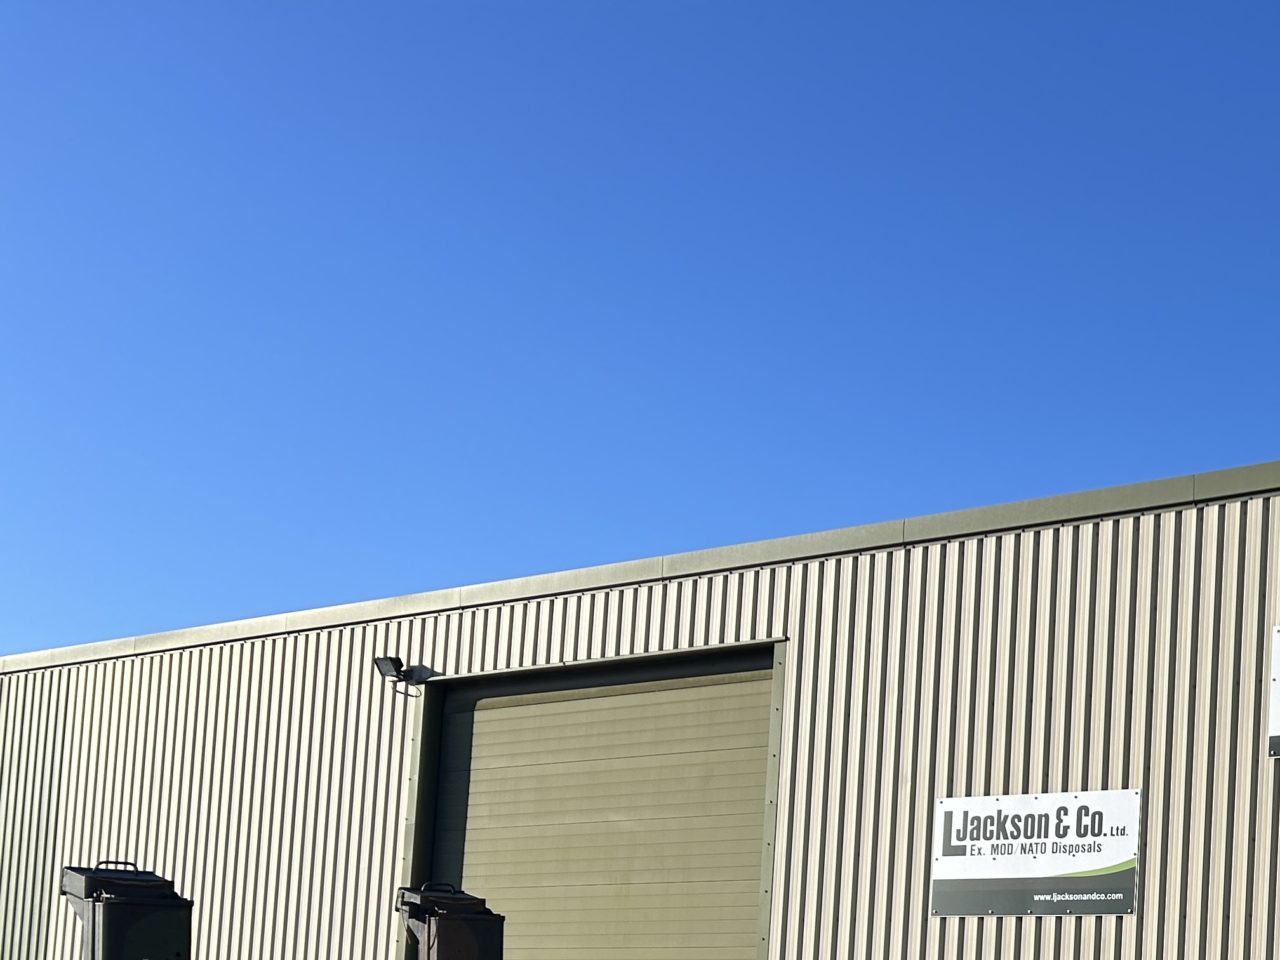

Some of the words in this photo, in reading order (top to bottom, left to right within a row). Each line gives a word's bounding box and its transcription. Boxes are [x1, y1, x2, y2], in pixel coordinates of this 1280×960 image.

[1055, 806, 1070, 838] &
[1076, 805, 1107, 838] Co.
[1110, 825, 1128, 837] Ltd.
[970, 844, 985, 856] Ex.
[990, 842, 1047, 855] MOD/NATO
[1052, 840, 1102, 855] Disposals
[1033, 892, 1123, 903] www.ljacksonandco.com
